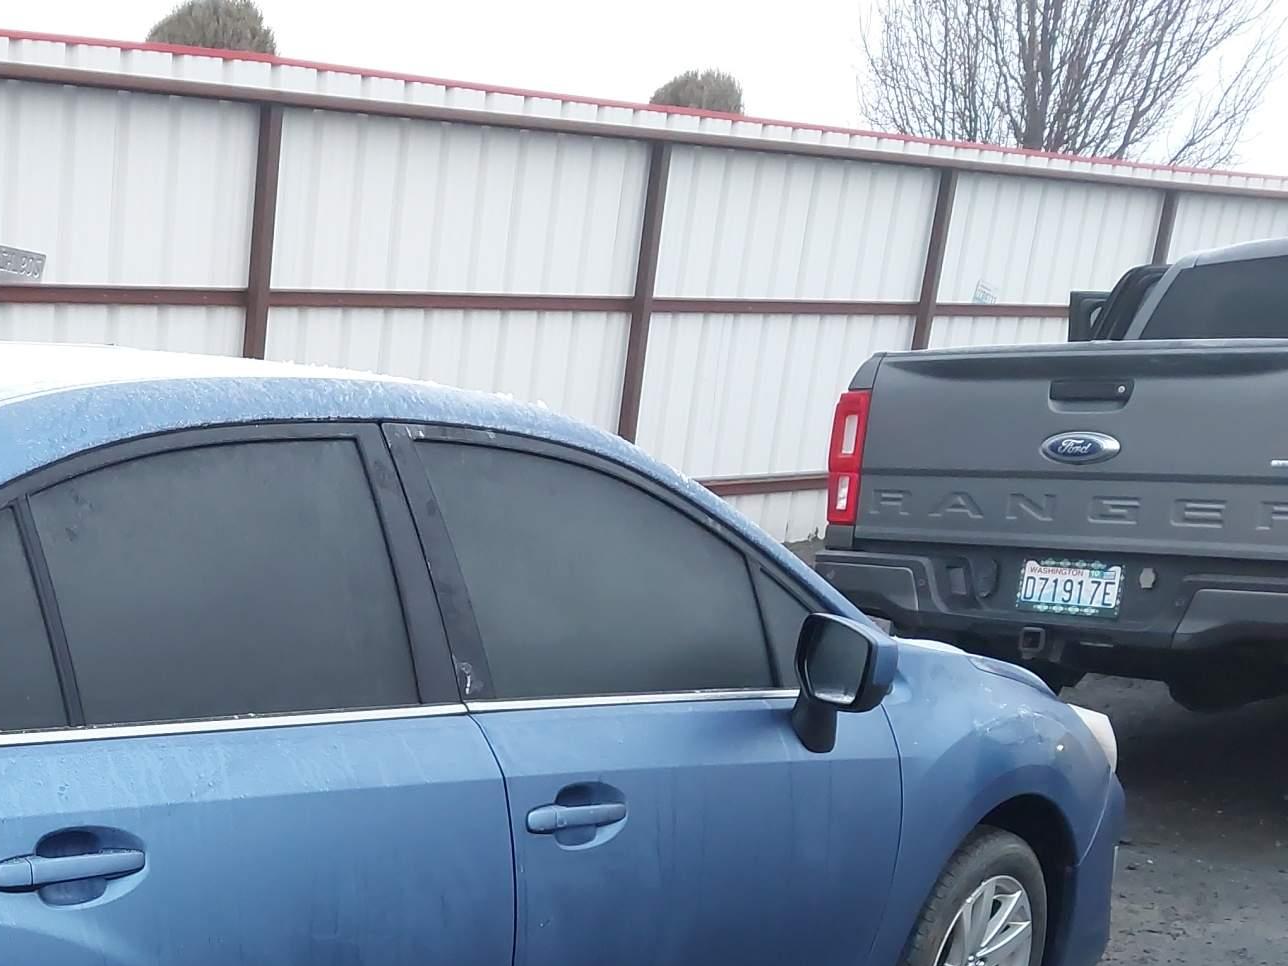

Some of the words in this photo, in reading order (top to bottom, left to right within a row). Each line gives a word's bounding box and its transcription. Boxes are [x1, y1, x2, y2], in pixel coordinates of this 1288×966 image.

[1057, 439, 1092, 454] Ford
[1030, 566, 1084, 577] WASHINGTON
[1023, 575, 1116, 606] D71917E
